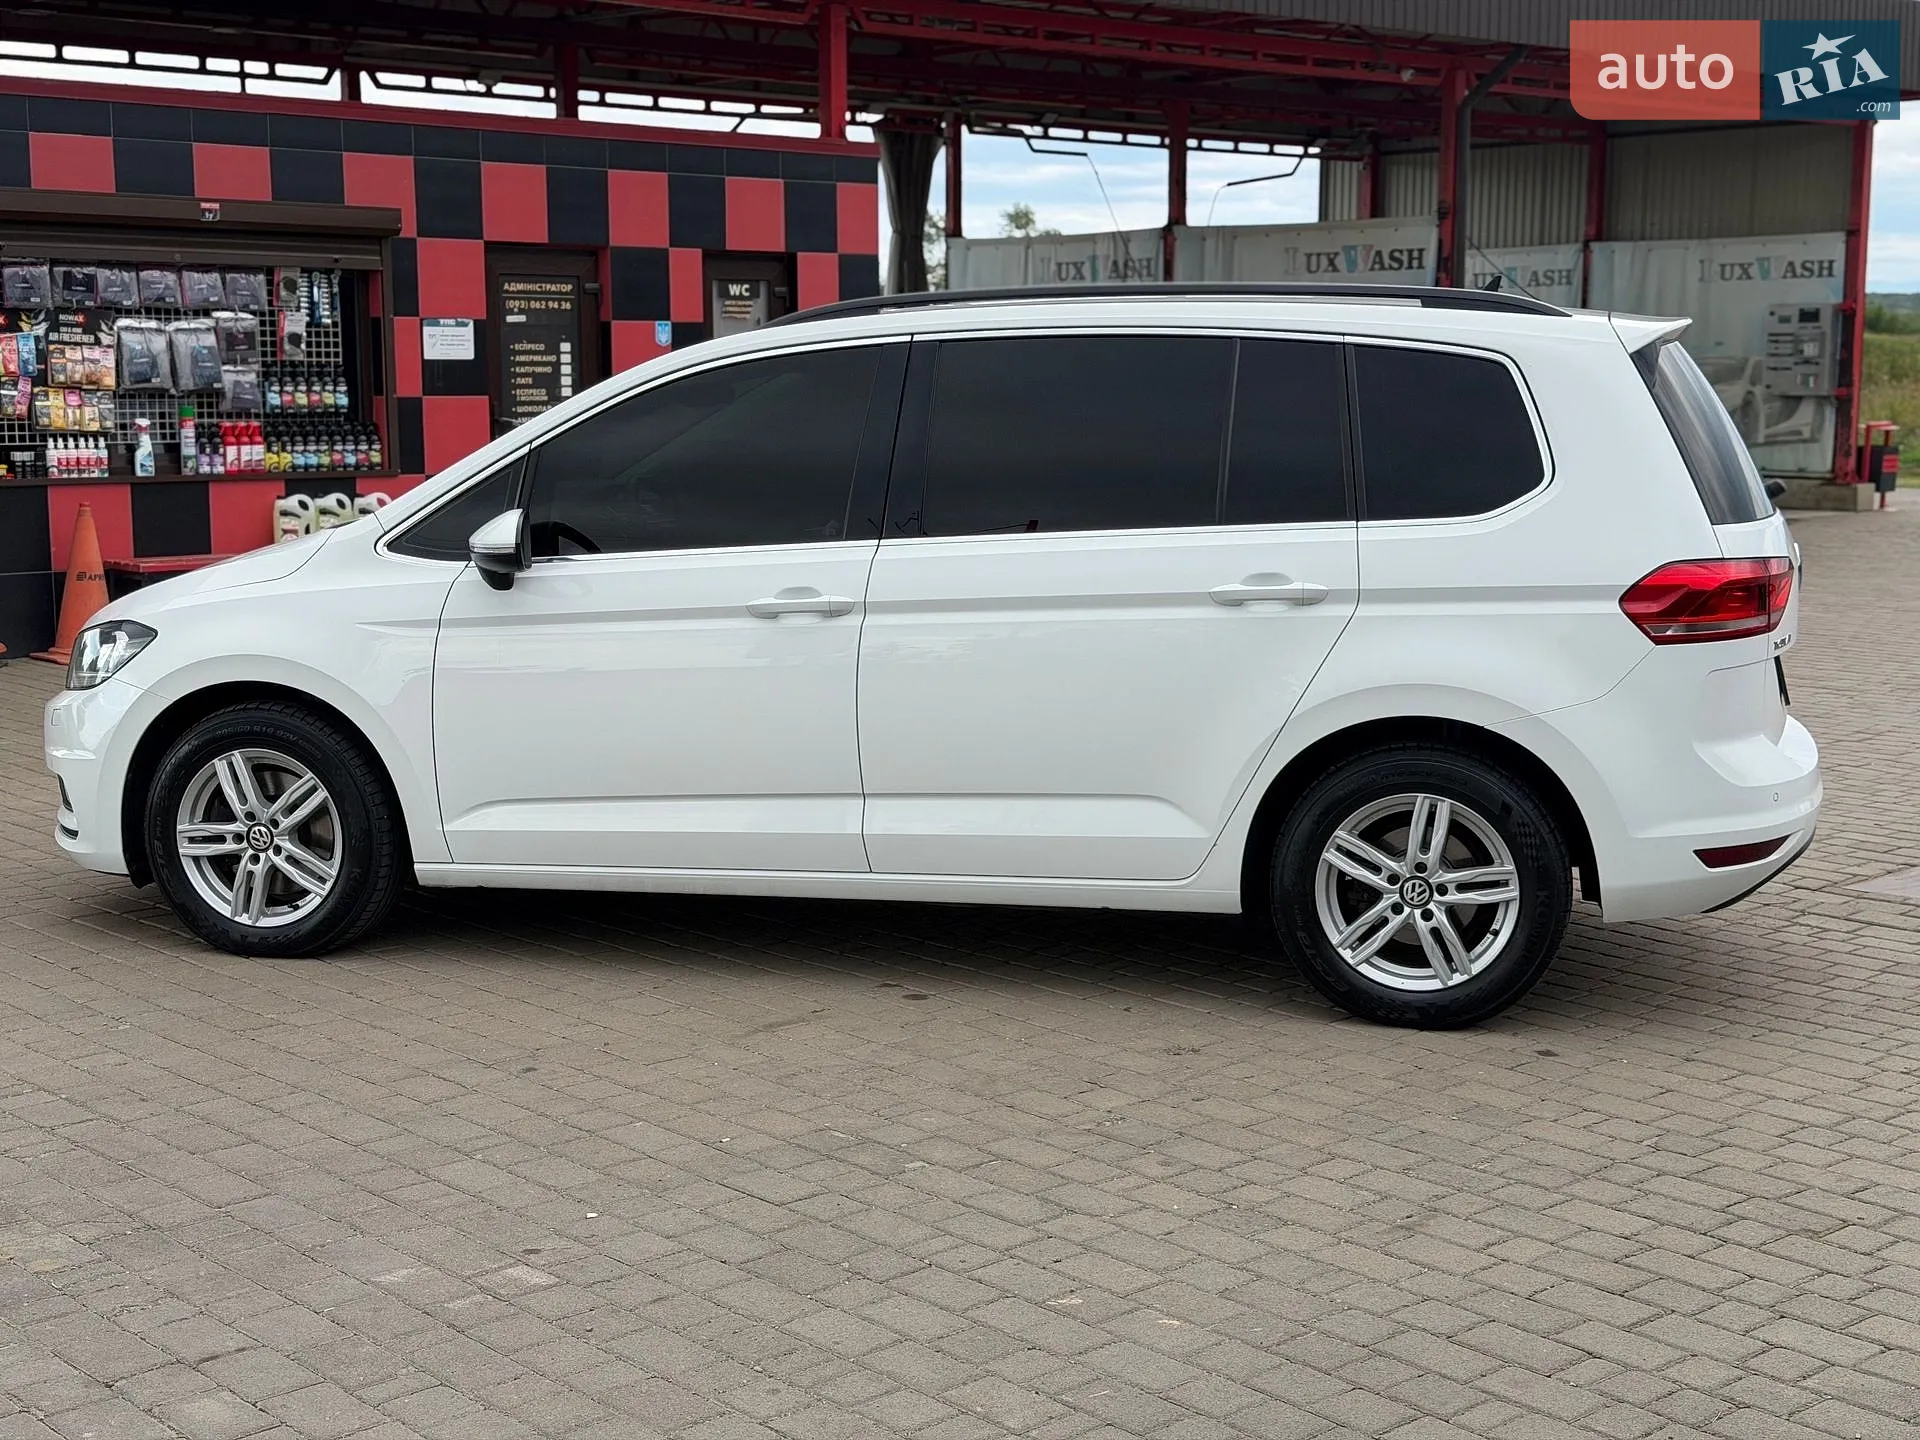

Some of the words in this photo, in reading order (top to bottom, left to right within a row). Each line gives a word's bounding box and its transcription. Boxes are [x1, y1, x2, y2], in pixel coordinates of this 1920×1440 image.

[503, 282, 573, 292] АДМІНІСТРАТОР
[728, 283, 750, 296] WC
[505, 300, 528, 309] (093)
[530, 300, 546, 309] 062
[547, 300, 559, 309] 94
[49, 332, 59, 341] AIR
